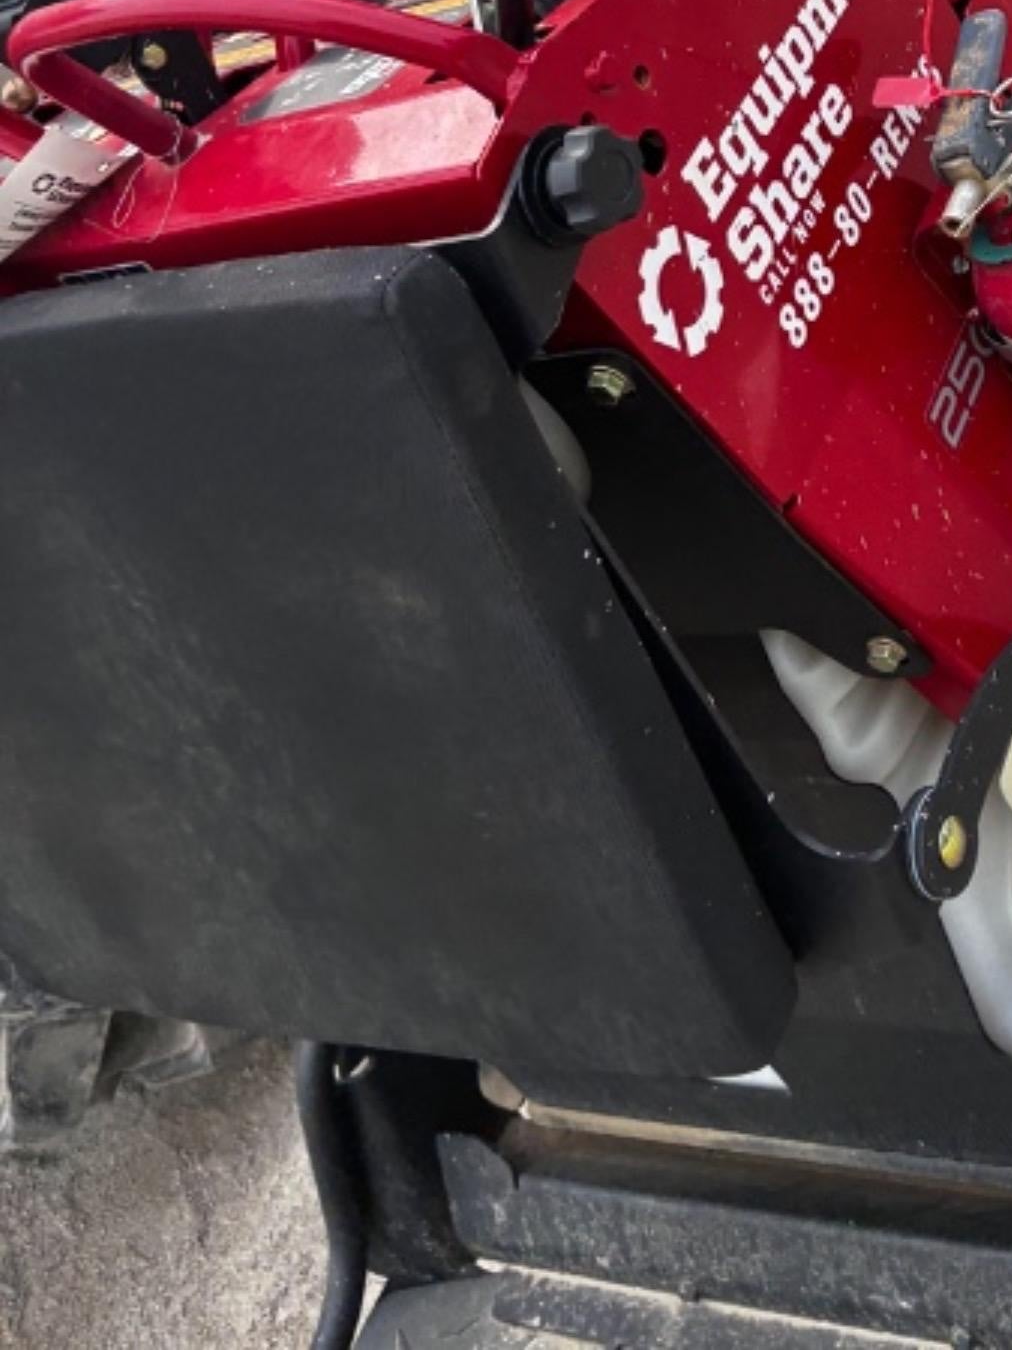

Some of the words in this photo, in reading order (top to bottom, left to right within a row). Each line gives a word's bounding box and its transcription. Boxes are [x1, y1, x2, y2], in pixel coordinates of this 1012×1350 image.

[725, 82, 854, 283] Share
[758, 245, 798, 306] CALL
[792, 187, 827, 245] NOW
[778, 53, 943, 349] 888-80-RENS
